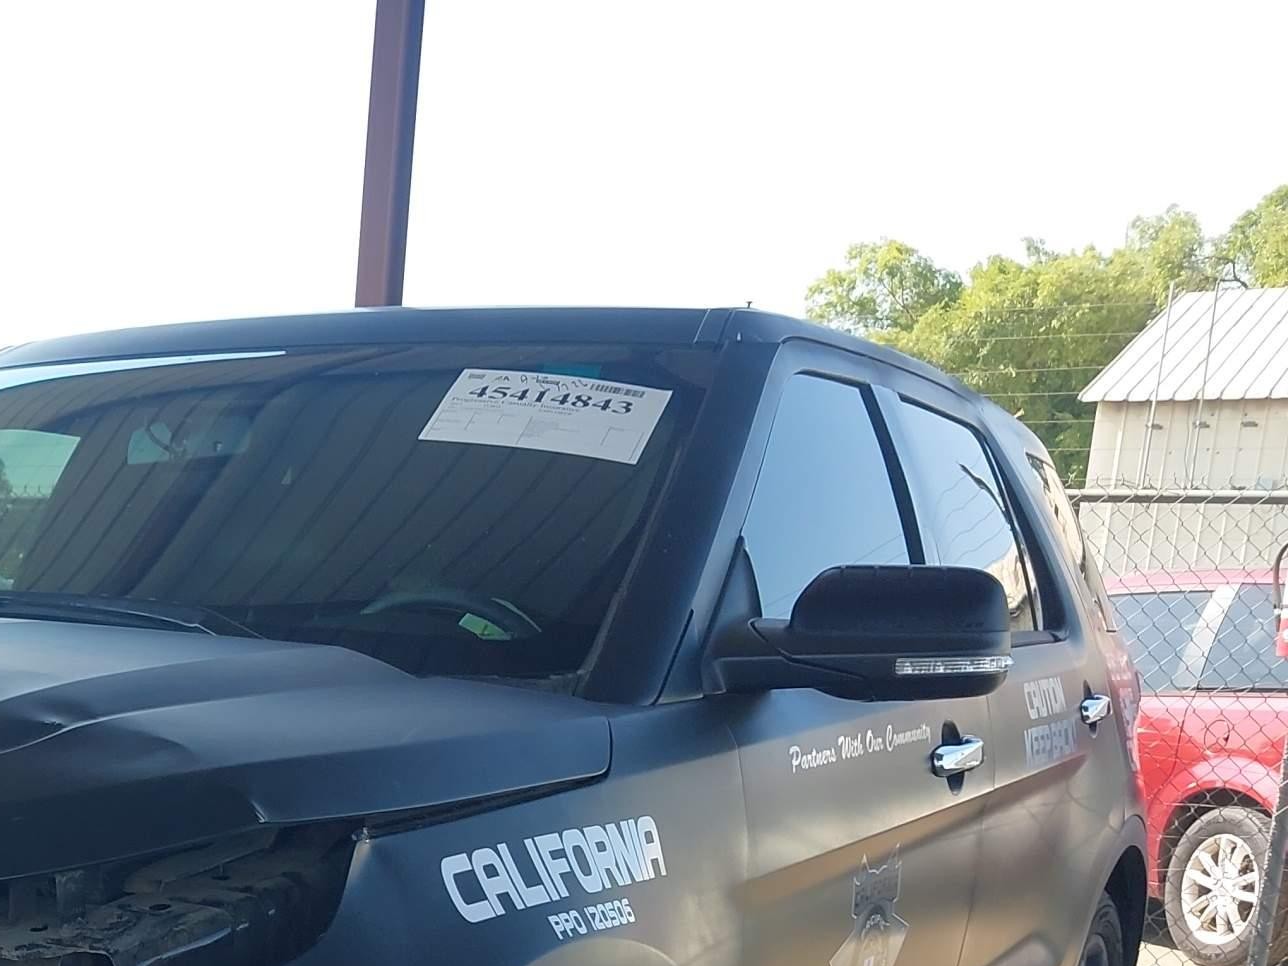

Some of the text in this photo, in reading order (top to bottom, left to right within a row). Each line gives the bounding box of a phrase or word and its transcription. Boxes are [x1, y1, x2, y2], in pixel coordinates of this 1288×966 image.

[468, 384, 634, 415] 45414843
[1023, 676, 1066, 720] CAUTION
[789, 722, 931, 773] Partners With Our Community
[440, 815, 667, 923] CALIFORNIA
[548, 898, 636, 940] PPO 120506
